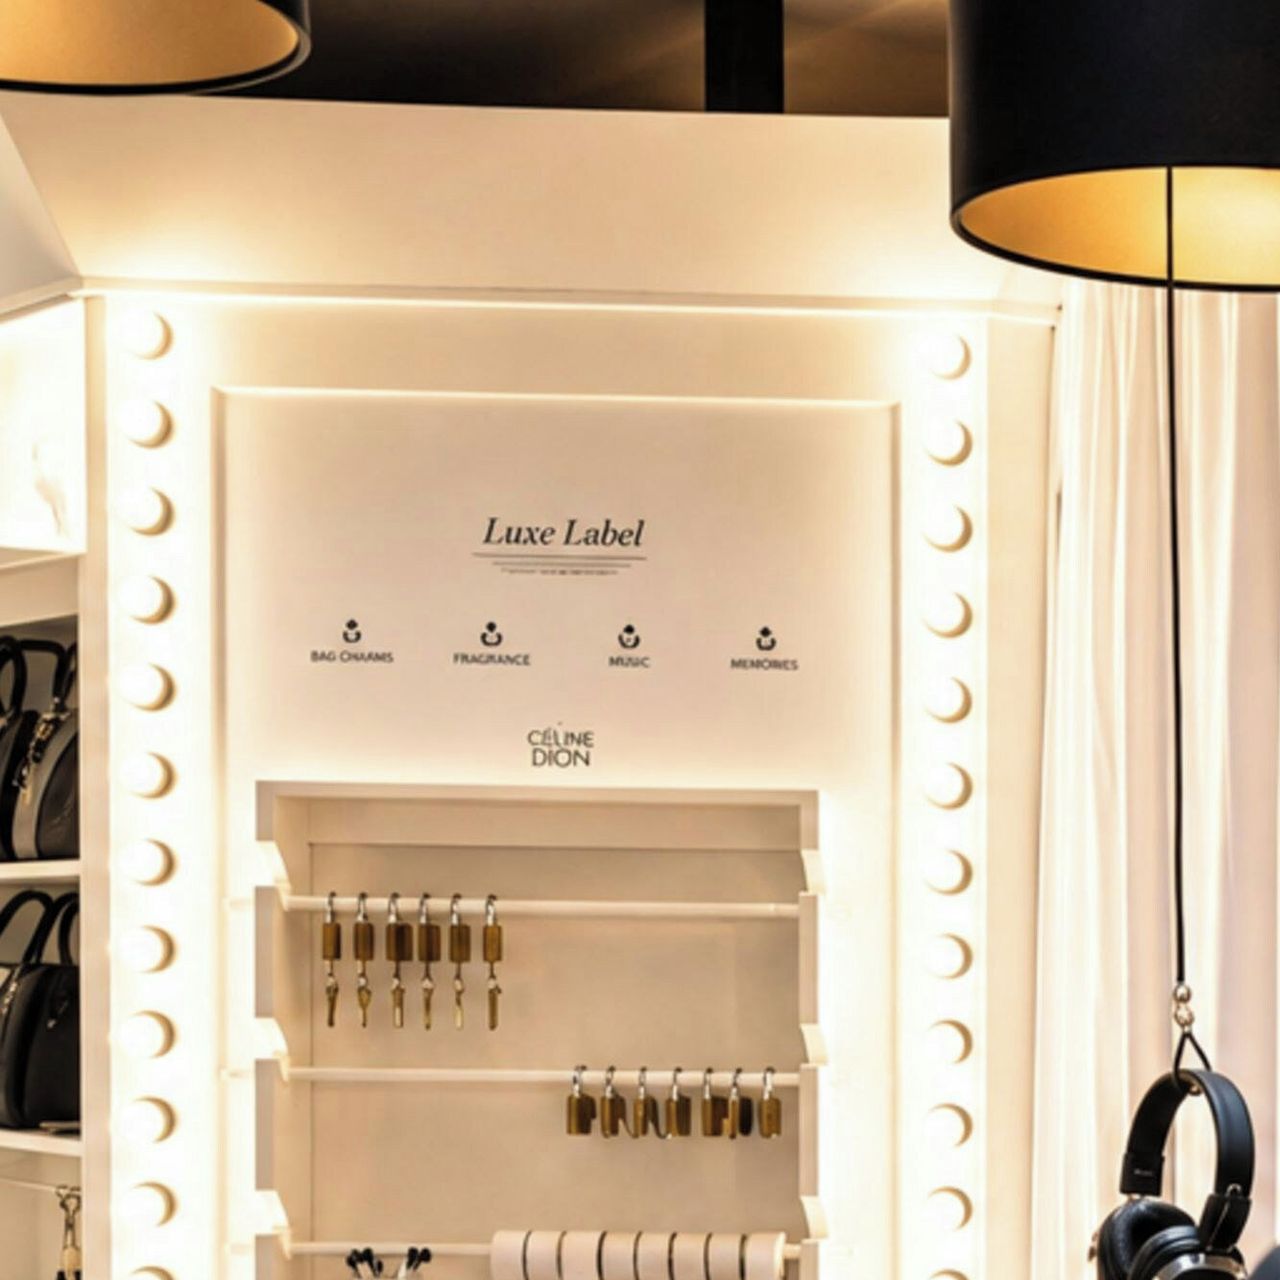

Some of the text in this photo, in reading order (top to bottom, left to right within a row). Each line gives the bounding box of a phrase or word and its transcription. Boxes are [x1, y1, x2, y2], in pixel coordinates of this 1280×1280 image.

[483, 517, 646, 547] Luxe Label
[310, 650, 394, 664] BAG CHARMS
[453, 653, 531, 666] FRAGRANCE
[608, 656, 651, 668] MUSIC
[730, 658, 799, 671] MEMORIES
[527, 726, 594, 748] CÉLINE
[532, 747, 590, 768] DION
